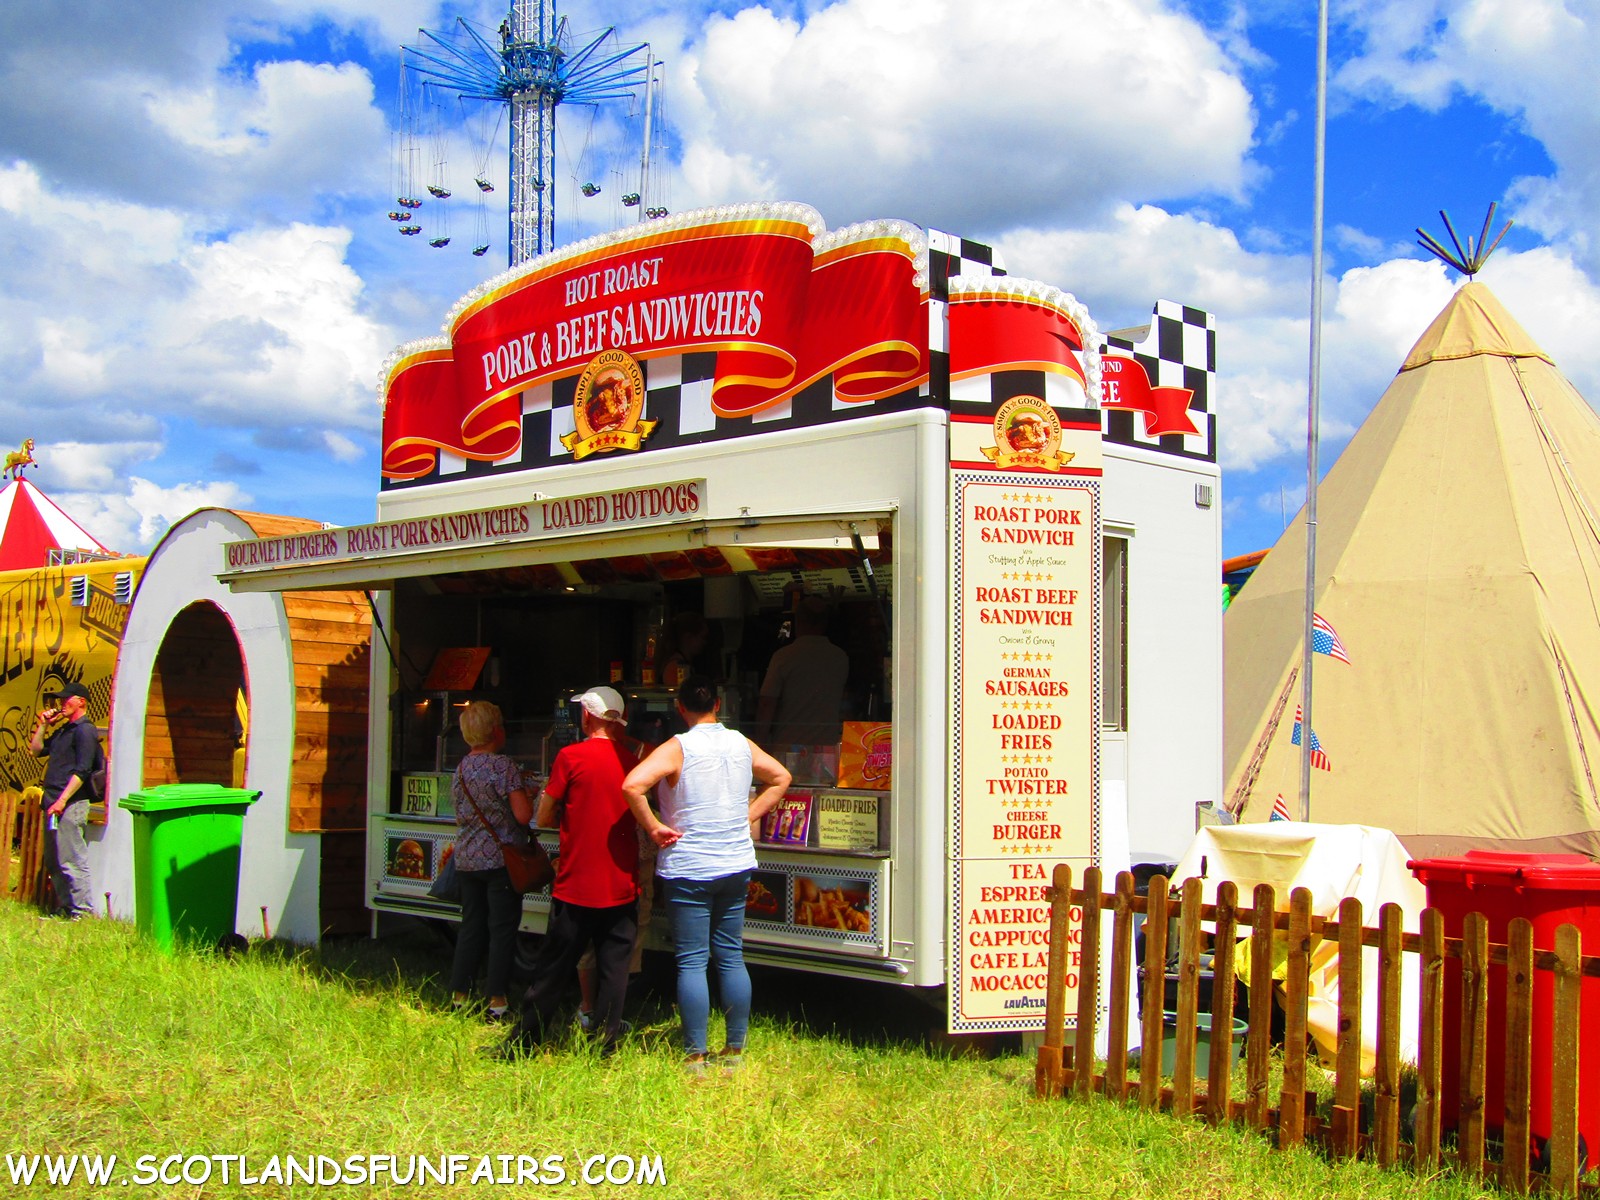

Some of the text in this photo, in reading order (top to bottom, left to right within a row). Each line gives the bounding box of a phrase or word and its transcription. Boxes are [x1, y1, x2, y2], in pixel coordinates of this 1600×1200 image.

[565, 257, 663, 306] HOT ROAST
[482, 290, 764, 391] PORK & BEEF SANDWICHES
[1100, 361, 1122, 373] UND
[576, 352, 641, 407] SIMPLY GOOD FOOD
[996, 397, 1060, 434] SIMPLY GOOD FOOD
[974, 505, 1081, 525] ROAST PORK
[228, 539, 282, 567] GOURMET
[283, 532, 338, 561] BURGERS
[347, 525, 388, 553] ROAST
[390, 519, 430, 550] PORK
[430, 505, 529, 543] SANDWICHES
[542, 494, 609, 530] LOADED
[980, 527, 1074, 546] SANDWICH
[988, 554, 1067, 567] Stuffing & Apple Sauce
[976, 586, 1078, 605] ROAST BEEF
[88, 592, 127, 632] BURGE
[980, 608, 1073, 627] SANDWICH
[998, 635, 1055, 647] Onions & Gravy
[1003, 667, 1051, 678] GERMAN
[985, 680, 1069, 697] SAUSAGES
[992, 713, 1062, 730] LOADED
[1001, 734, 1053, 750] FRIES
[867, 753, 892, 768] TWIST
[1004, 767, 1049, 778] POTATO
[407, 778, 432, 794] CURLY
[986, 779, 1068, 795] TWISTER
[406, 795, 432, 813] FRIES
[770, 797, 807, 812] RAPPES
[820, 798, 877, 815] LOADED FRIES
[1006, 811, 1049, 823] CHEESE
[993, 825, 1062, 841] BURGER
[1009, 863, 1047, 880] TEA
[980, 886, 1048, 903] ESPRES
[968, 907, 1082, 925] AMERICAO
[969, 929, 1083, 947] CAPPUCCNO
[970, 951, 1081, 970] CAFE LAE
[970, 974, 1078, 992] MOCACCO
[1004, 995, 1047, 1009] LAVAZZA
